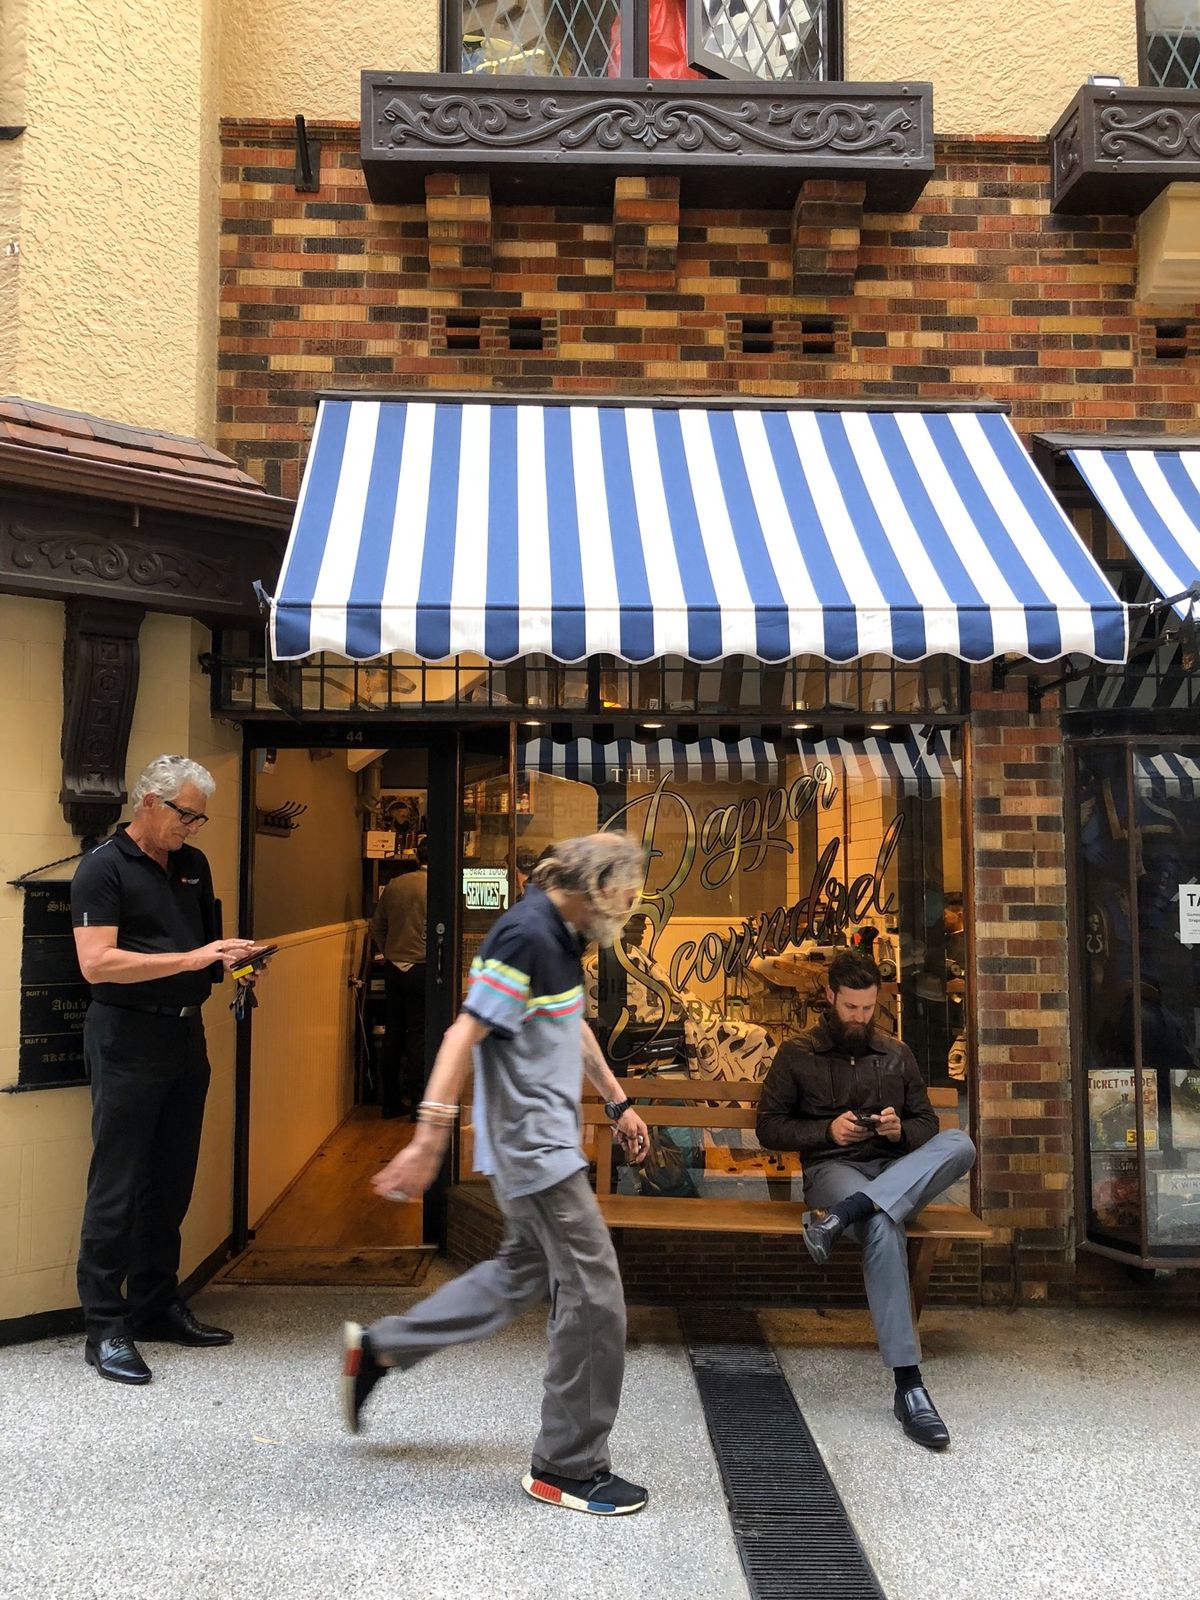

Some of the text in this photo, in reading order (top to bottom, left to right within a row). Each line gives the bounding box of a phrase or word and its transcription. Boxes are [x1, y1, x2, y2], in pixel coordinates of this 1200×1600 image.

[346, 730, 363, 742] 44
[611, 768, 655, 783] THE
[599, 762, 838, 898] Dapper
[467, 883, 499, 906] SERVICES
[47, 900, 71, 912] Sha
[608, 813, 905, 1061] Scoundrel
[64, 1011, 87, 1020] BOUT
[1088, 1077, 1119, 1090] TICKET
[1130, 1076, 1152, 1087] RDE
